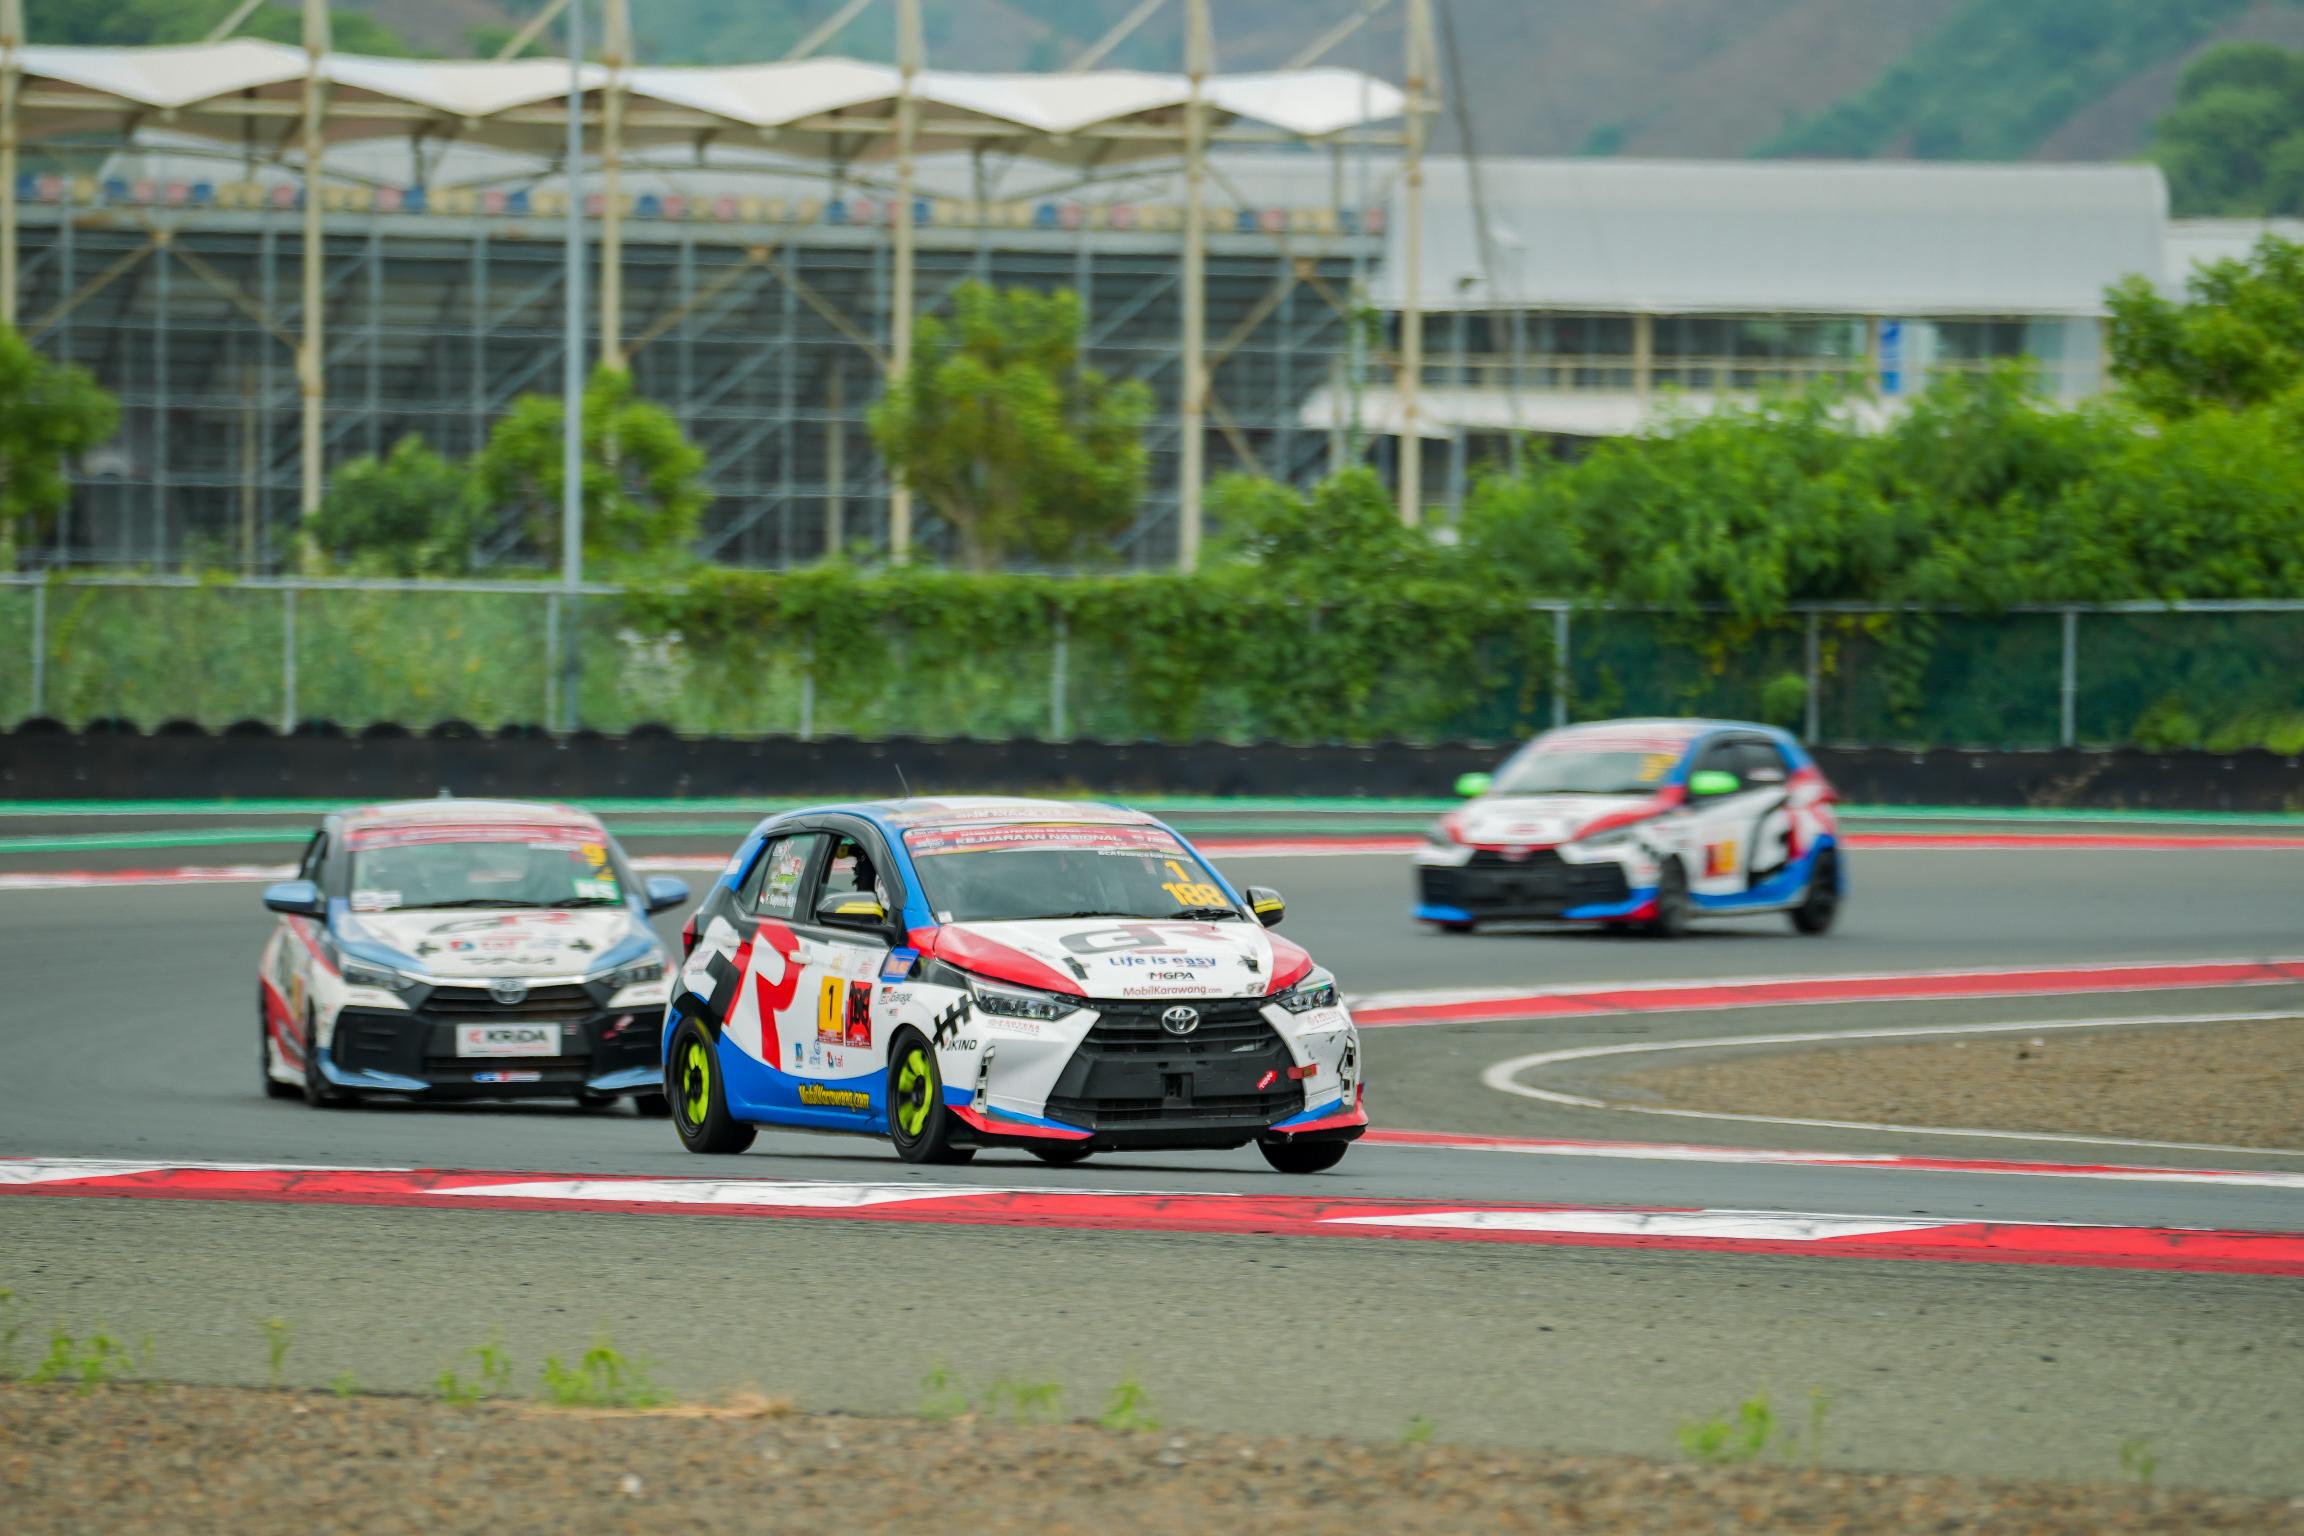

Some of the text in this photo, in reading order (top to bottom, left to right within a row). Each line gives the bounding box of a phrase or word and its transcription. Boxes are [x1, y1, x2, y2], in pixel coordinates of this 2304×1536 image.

[955, 834, 1046, 846] KEJUARAAN
[1050, 834, 1123, 842] NASIONAL
[1164, 860, 1190, 881] 1
[1161, 882, 1228, 908] 188
[1109, 956, 1216, 966] Life is easy
[1149, 971, 1195, 981] MGPA
[1122, 984, 1224, 996] MobilKarawang.com
[828, 984, 834, 1022] 1
